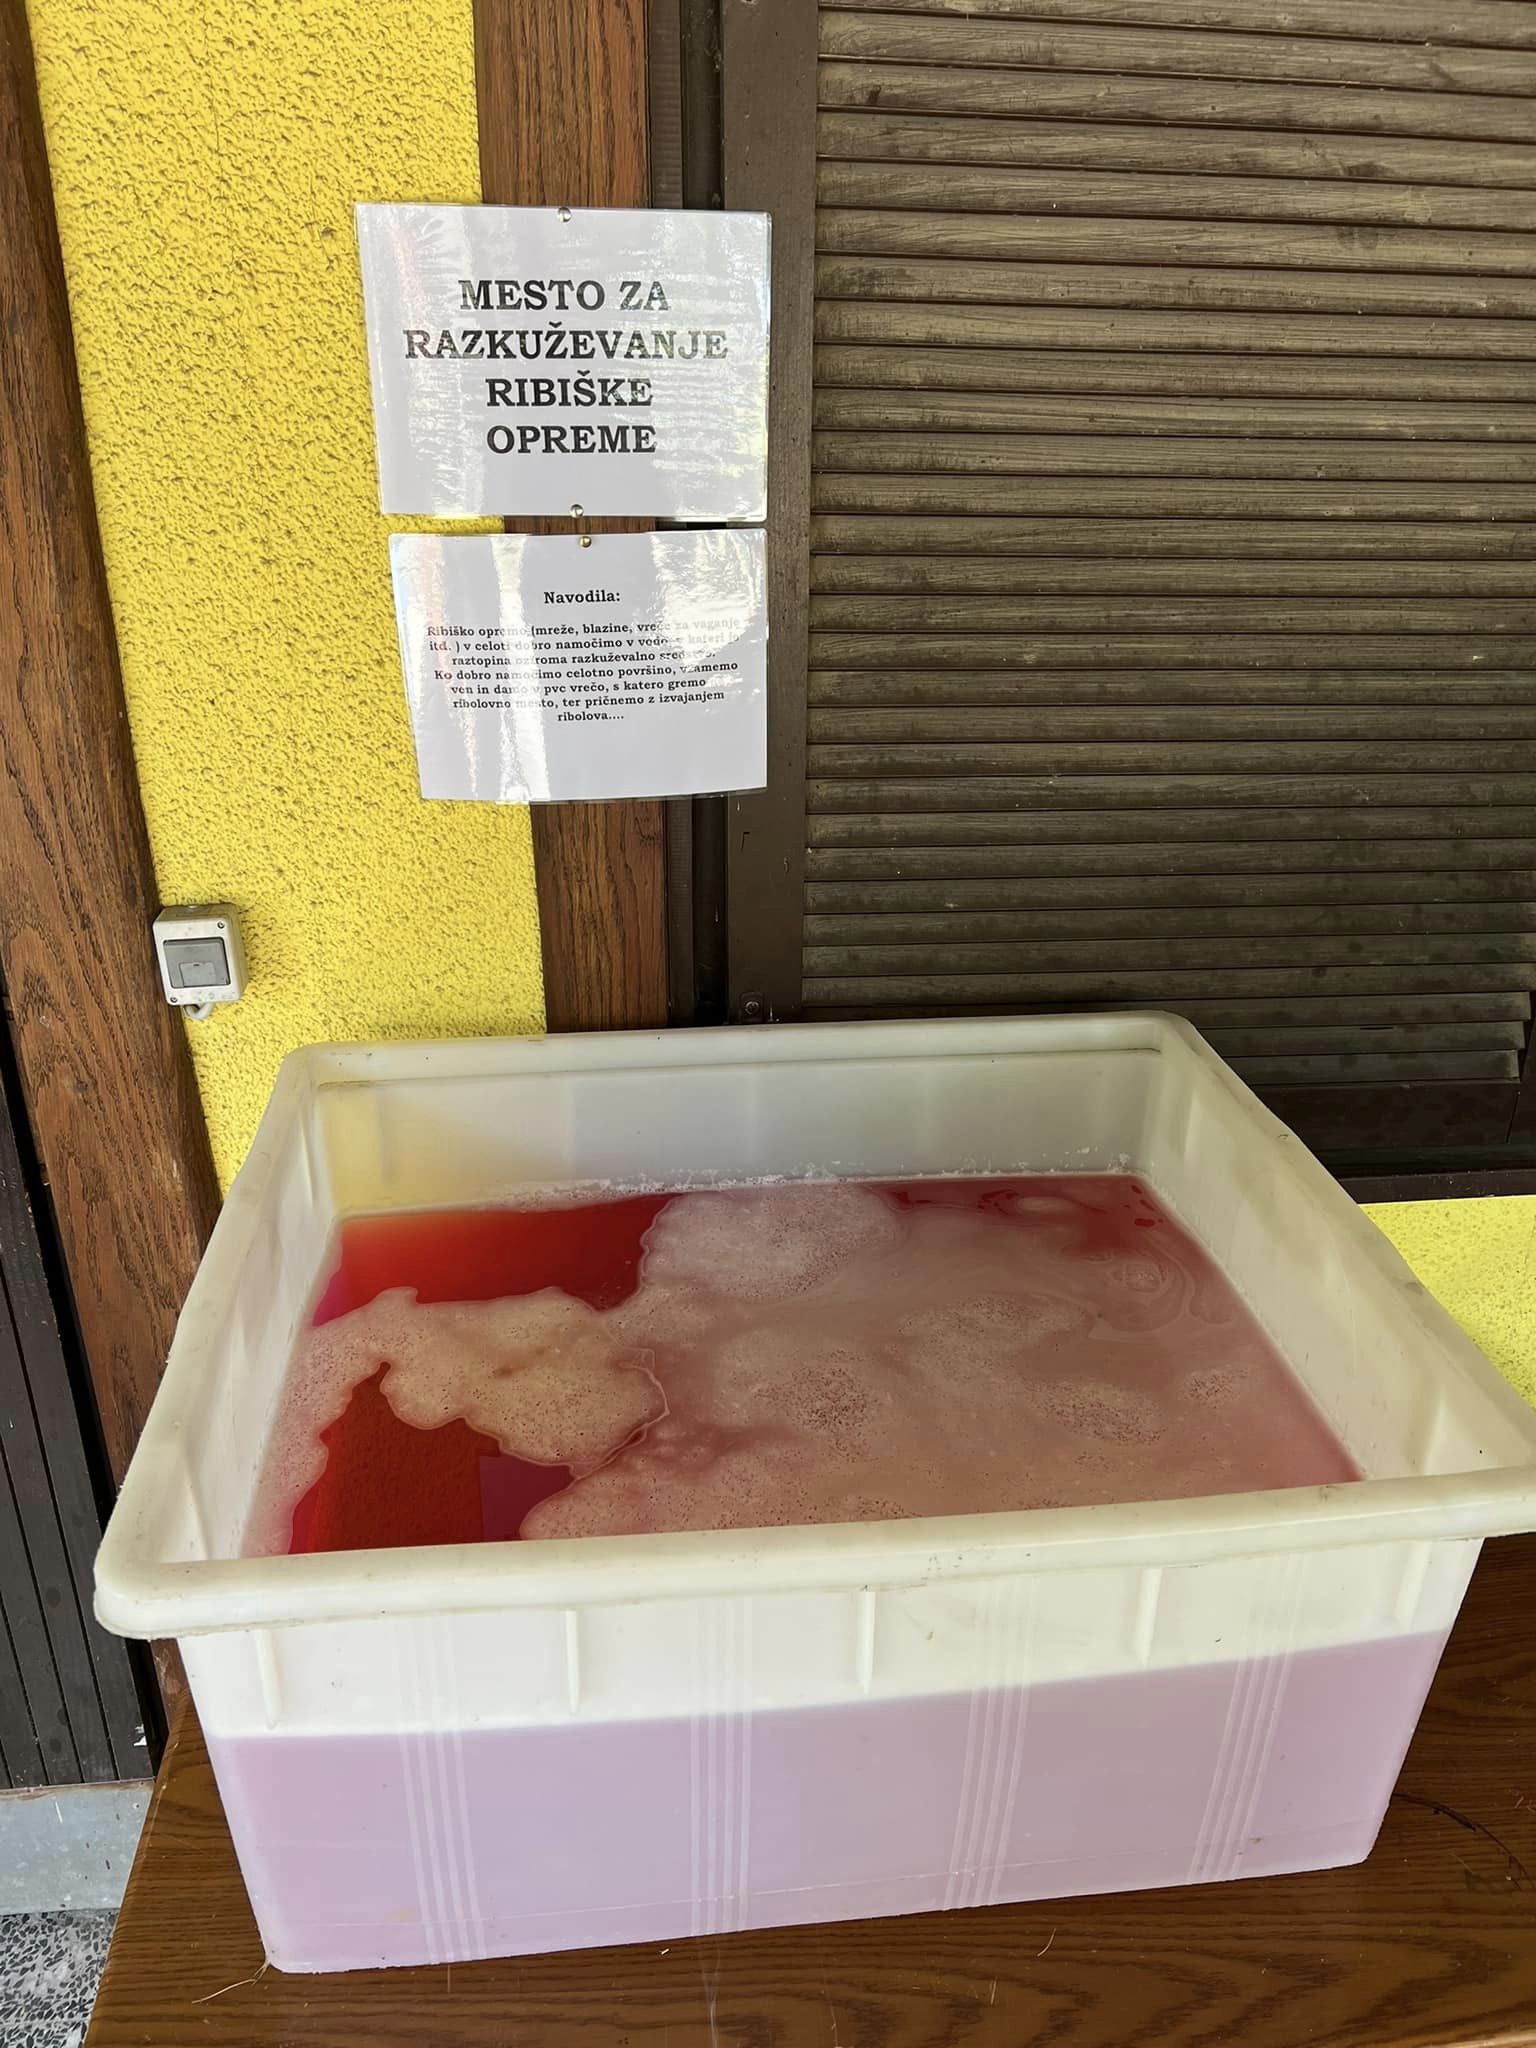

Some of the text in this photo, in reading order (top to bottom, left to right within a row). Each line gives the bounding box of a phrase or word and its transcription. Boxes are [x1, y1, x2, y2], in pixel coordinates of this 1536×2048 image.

[458, 279, 671, 311] MESTO ZA
[403, 321, 728, 359] RAZKUŽEVANJE
[485, 370, 653, 407] RIBIŠKE
[487, 425, 656, 454] OPREME
[544, 589, 620, 604] Navodila:
[427, 625, 475, 636] Ribiško
[531, 624, 579, 637] (mreže,
[583, 622, 632, 634] blazine,
[430, 641, 451, 651] itd.
[463, 643, 471, 651] v
[475, 641, 510, 651] celoti
[556, 638, 623, 650] namočimo
[626, 639, 634, 647] v
[452, 656, 511, 668] raztopina
[572, 651, 655, 664] razkuževalno
[434, 670, 453, 680] Ko
[456, 670, 491, 680] dobro
[566, 668, 614, 678] celotno
[618, 665, 676, 679] površino,
[451, 686, 474, 694] ven
[477, 684, 490, 694] in
[544, 685, 566, 695] pvc
[570, 682, 609, 693] vrečo,
[613, 683, 620, 691] s
[624, 681, 664, 691] katero
[668, 679, 706, 691] gremo
[453, 698, 511, 708] ribolovno
[562, 698, 580, 707] ter
[585, 695, 644, 709] pričnemo
[648, 695, 655, 703] z
[659, 691, 725, 704] izvajanjem
[557, 711, 624, 722] ribolova....
